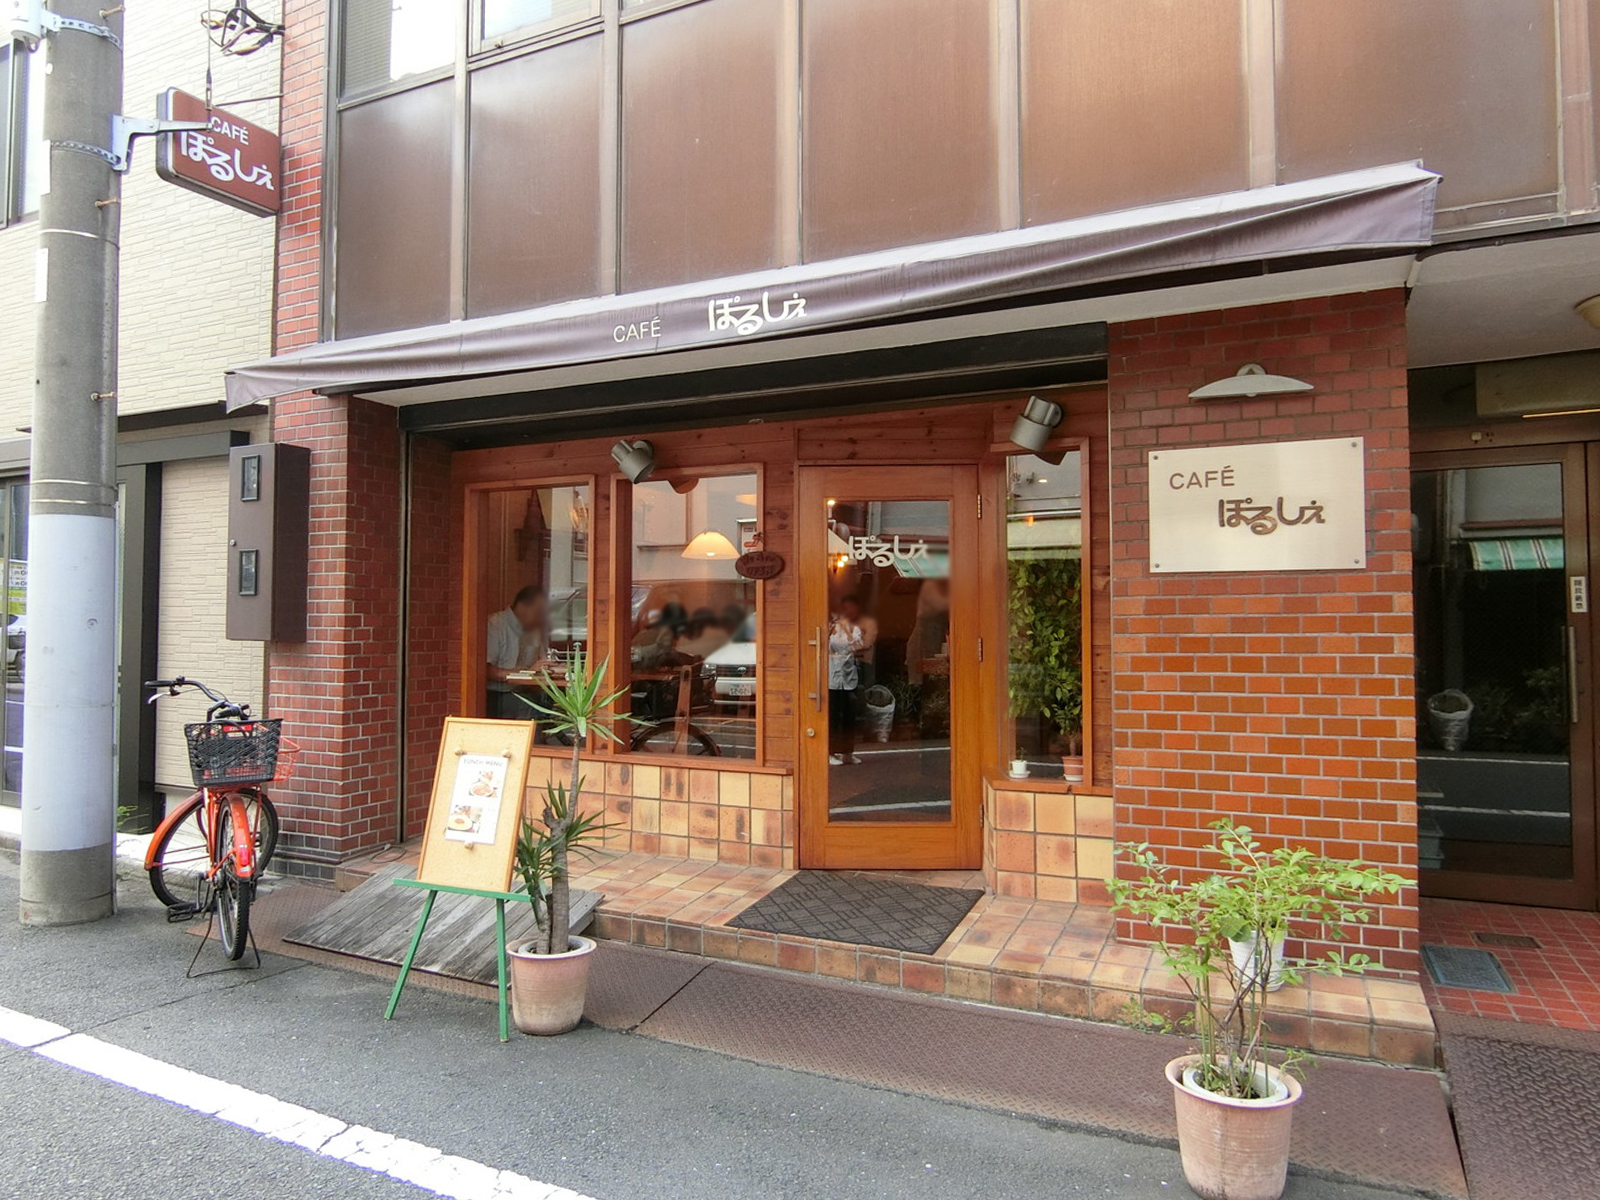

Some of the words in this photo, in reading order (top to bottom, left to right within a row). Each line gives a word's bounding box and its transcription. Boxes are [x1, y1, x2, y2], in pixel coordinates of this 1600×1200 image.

[210, 116, 249, 145] CAFÉ
[613, 316, 662, 343] CAFÉ
[1169, 465, 1235, 490] CAFÉ
